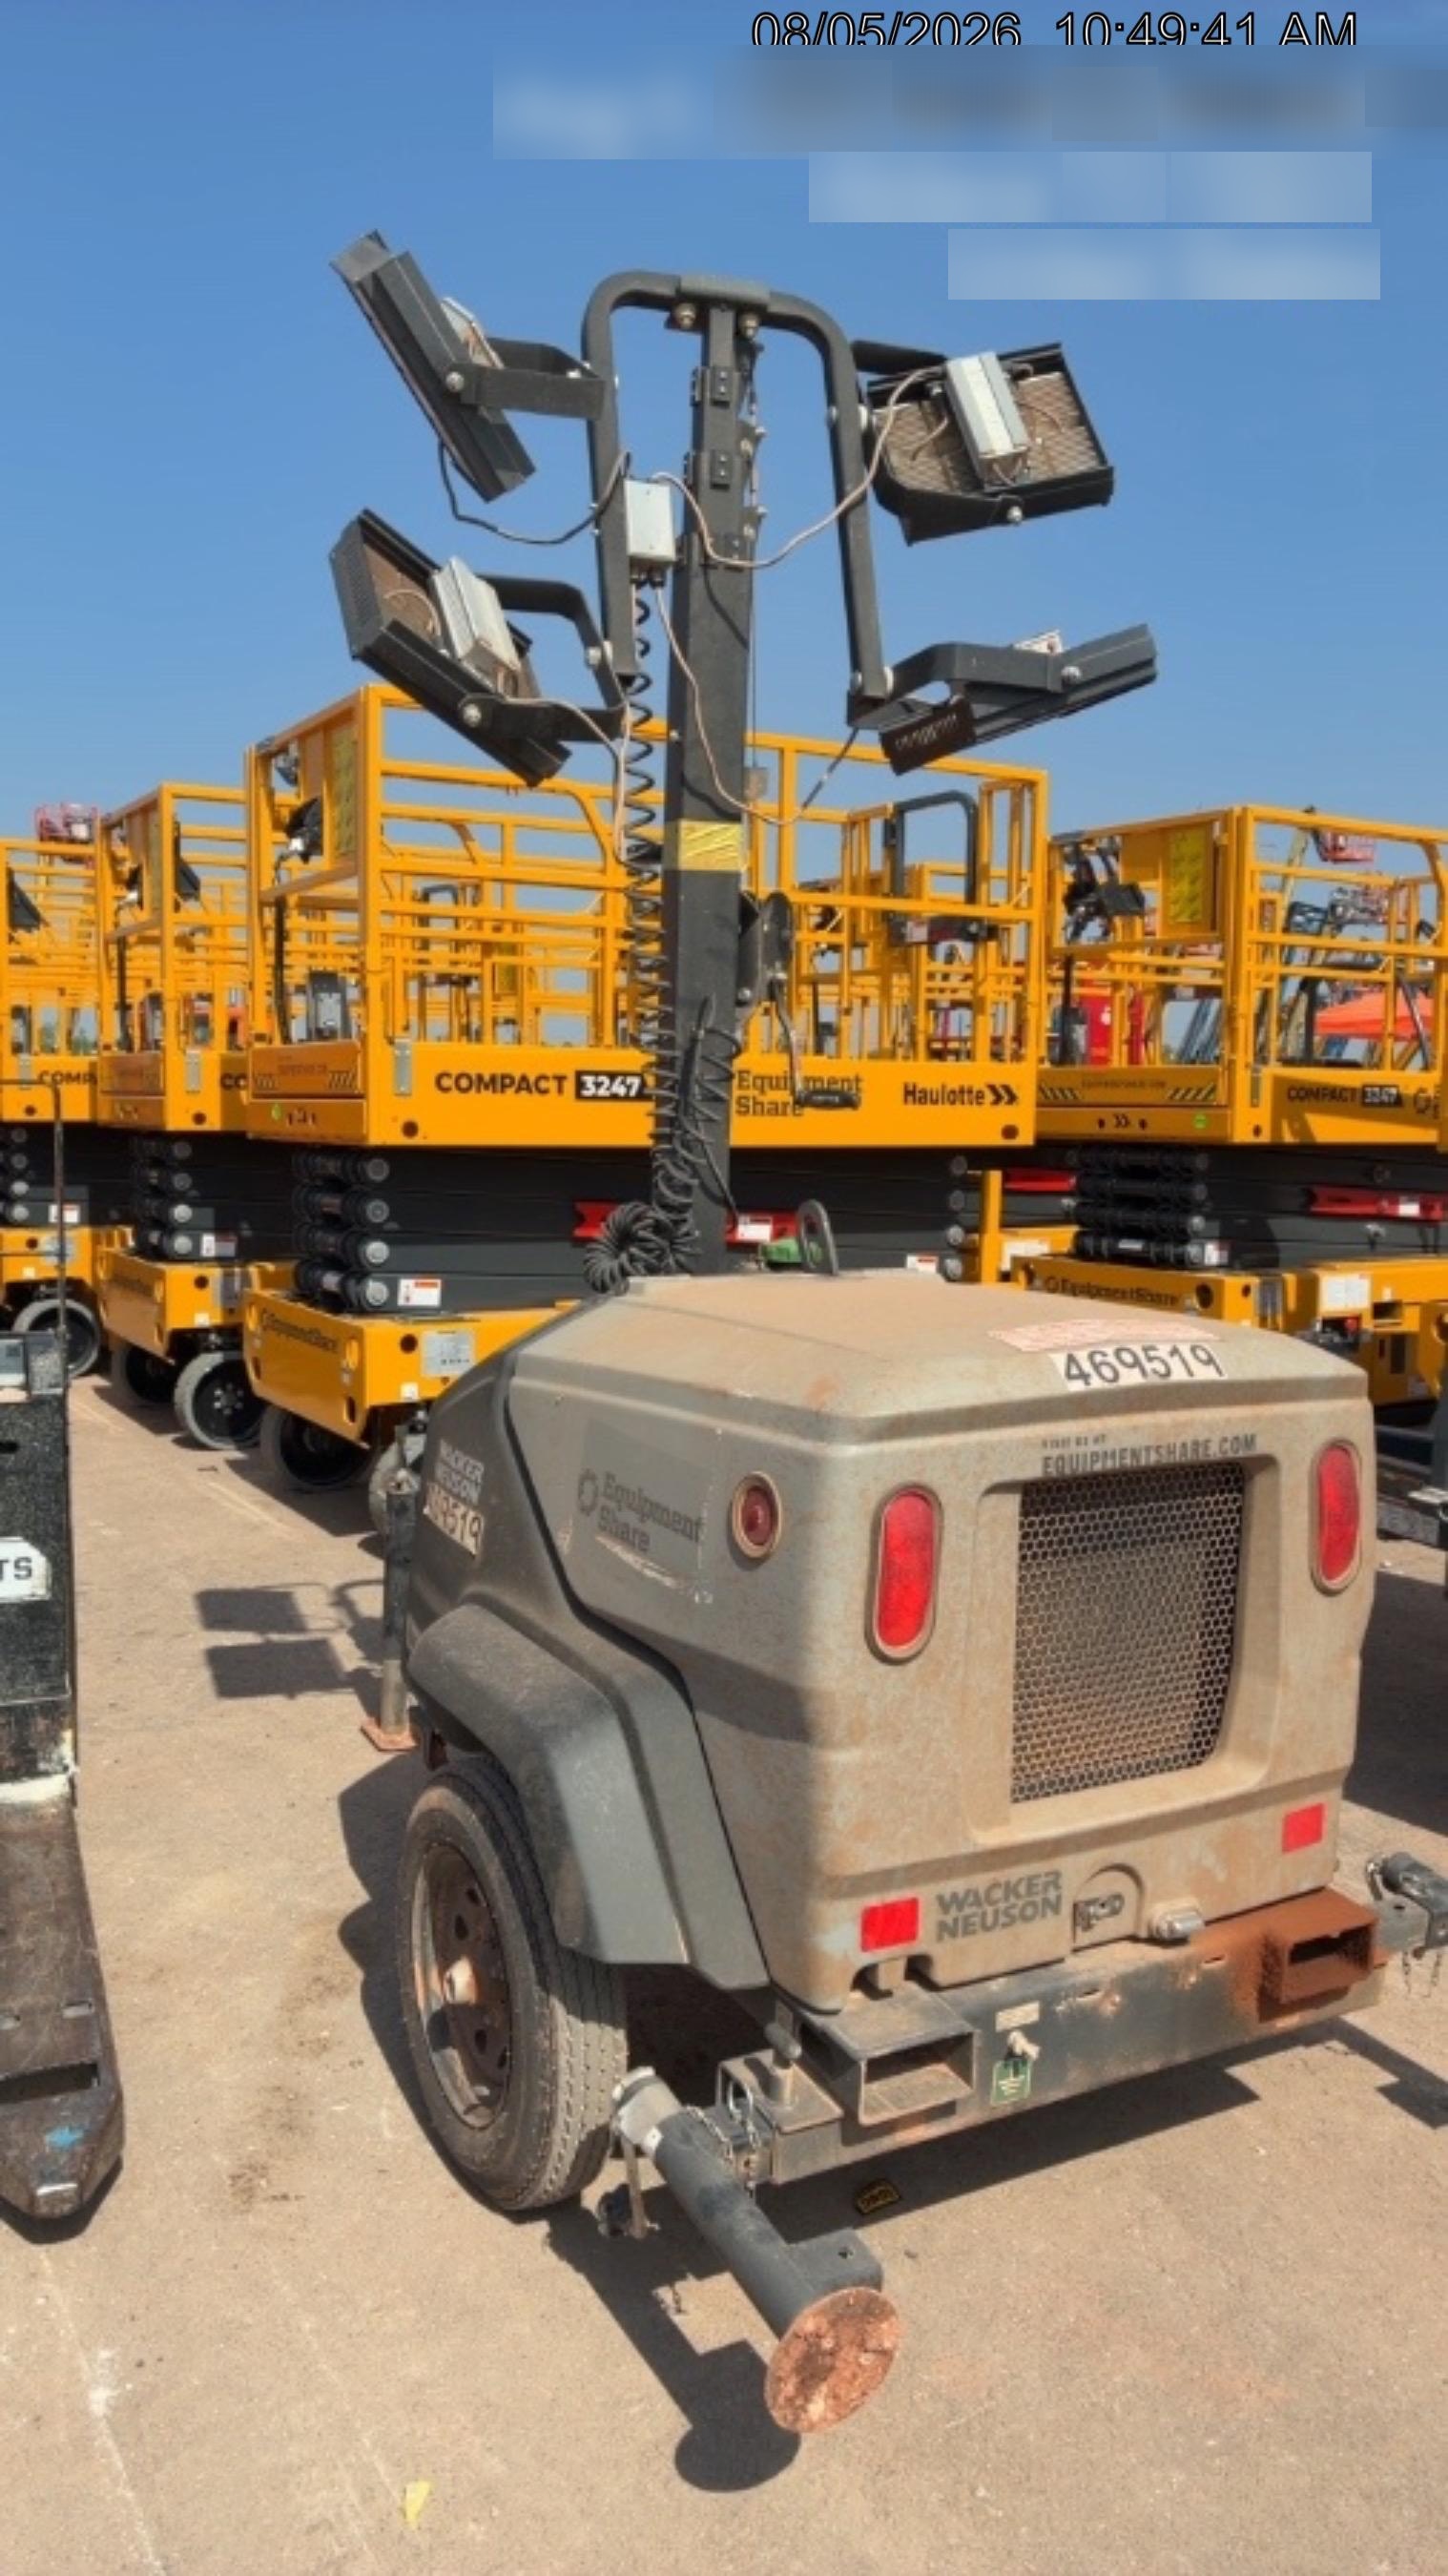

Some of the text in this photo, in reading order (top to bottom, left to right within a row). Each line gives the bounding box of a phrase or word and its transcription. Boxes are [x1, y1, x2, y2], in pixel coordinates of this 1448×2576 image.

[435, 1071, 642, 1096] COMPACT 3247
[735, 1070, 862, 1096] Equiment
[903, 1083, 984, 1106] Haulotte
[1065, 1344, 1224, 1386] 469519
[1043, 1433, 1257, 1478] EQUIPMENTSHARE.COM
[936, 1870, 1063, 1915] WACKER
[937, 1894, 1063, 1942] NEUSON
